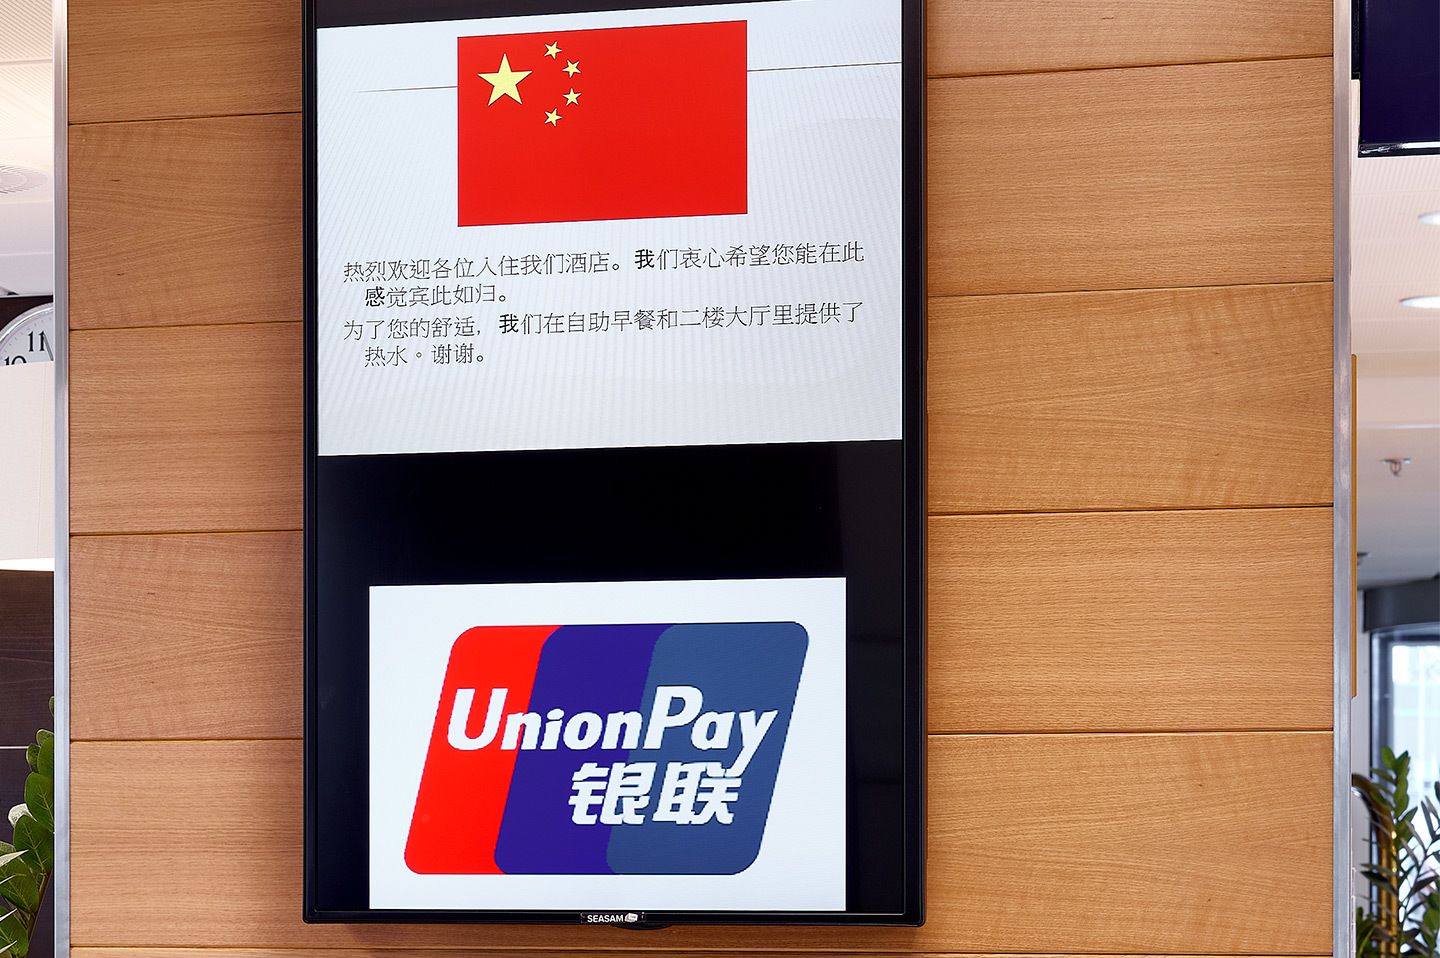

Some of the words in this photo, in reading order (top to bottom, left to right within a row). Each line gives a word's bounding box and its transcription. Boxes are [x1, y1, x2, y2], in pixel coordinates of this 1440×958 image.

[447, 685, 778, 777] UnionPay
[568, 761, 742, 825] 银联
[587, 915, 624, 923] SEASAM
